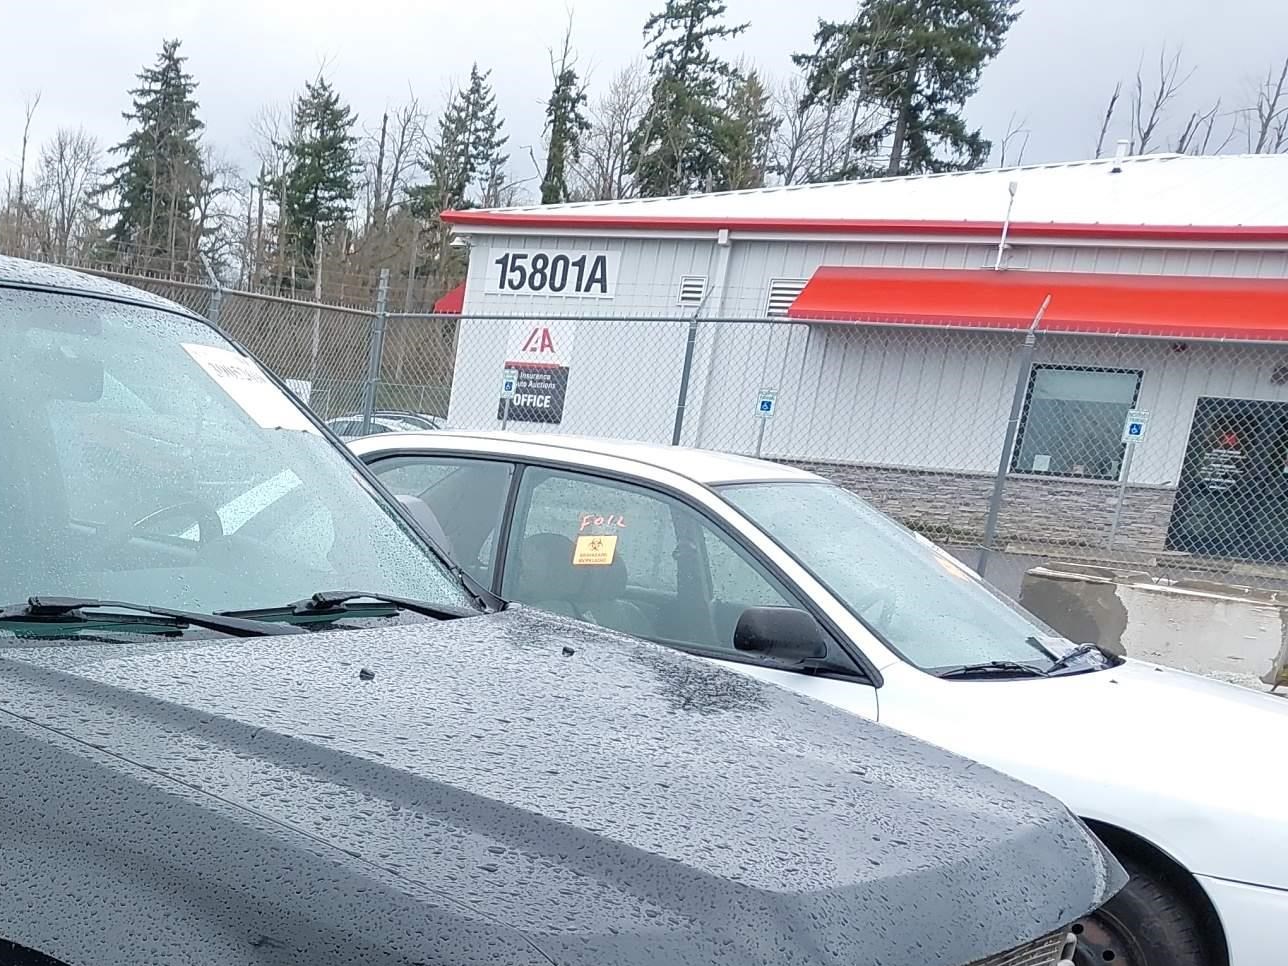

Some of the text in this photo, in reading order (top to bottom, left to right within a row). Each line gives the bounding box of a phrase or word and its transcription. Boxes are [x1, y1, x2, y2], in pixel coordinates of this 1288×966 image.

[494, 252, 608, 294] 15801A
[527, 380, 556, 389] Auctions
[513, 393, 552, 408] OFFICE
